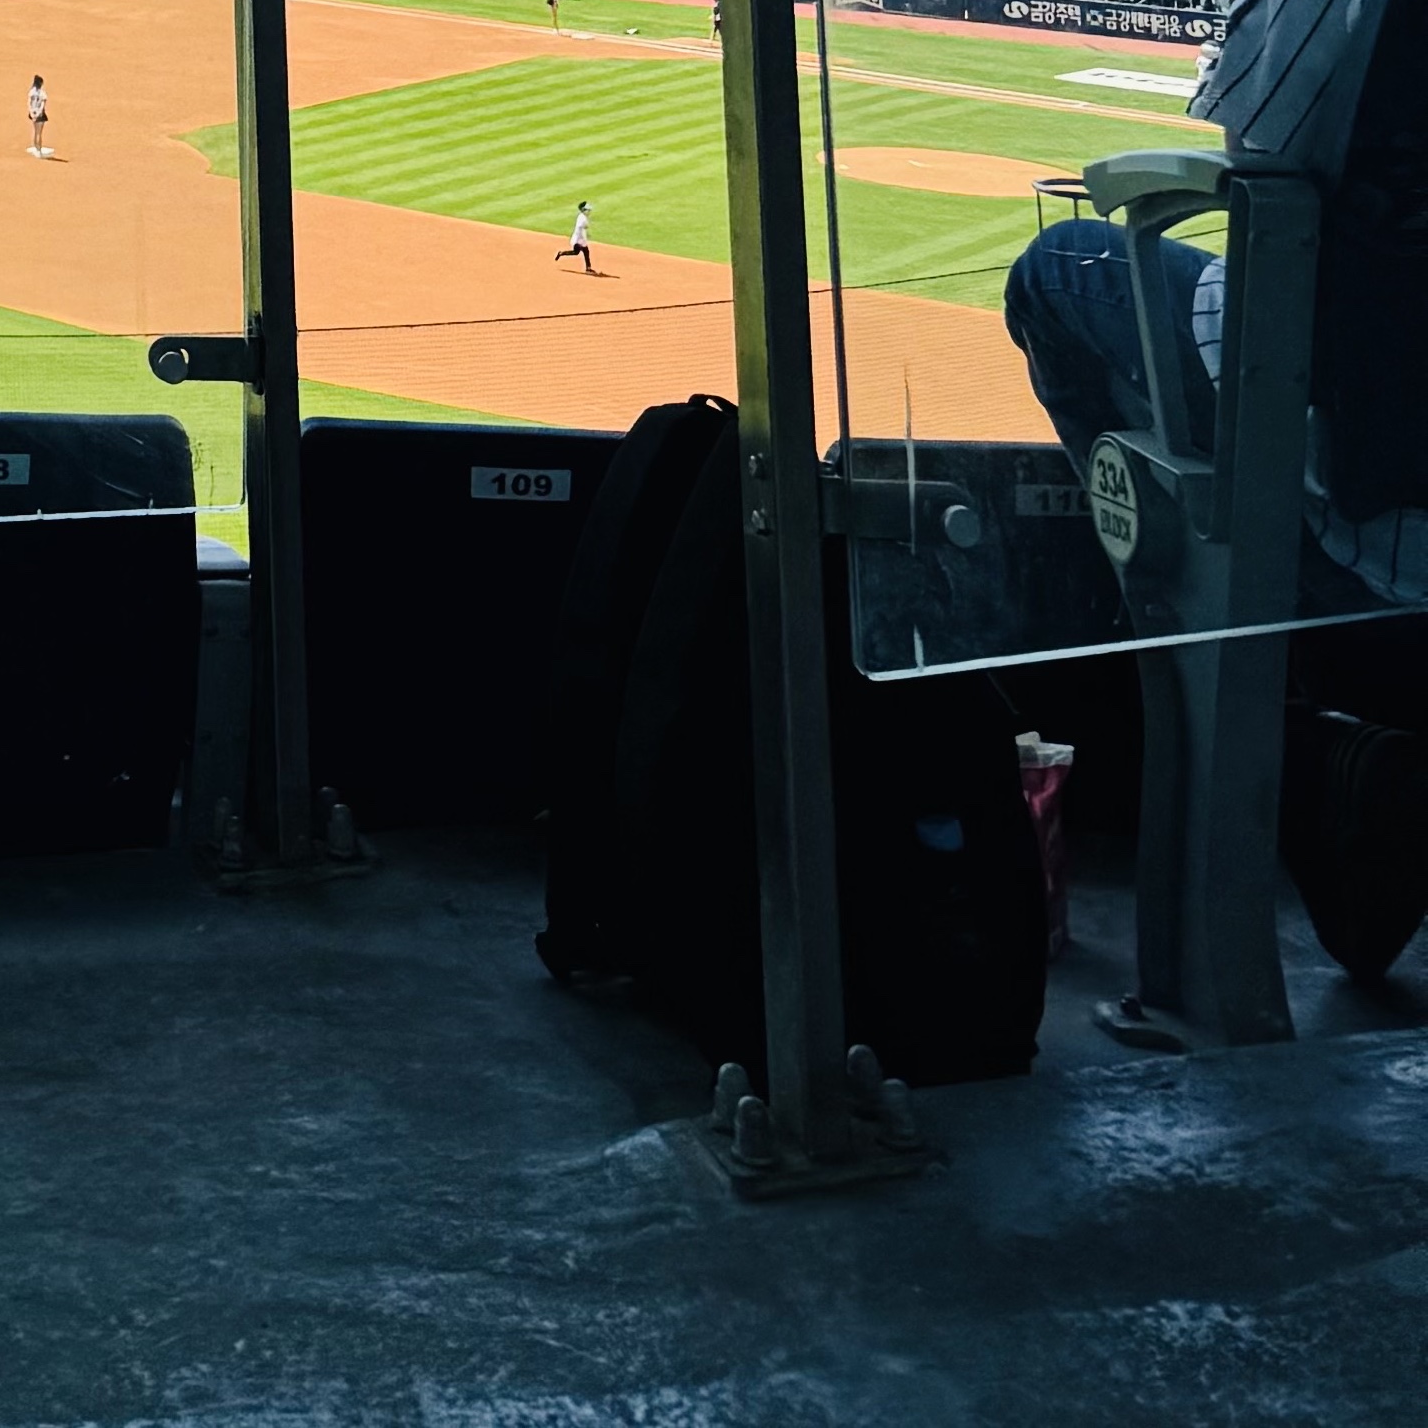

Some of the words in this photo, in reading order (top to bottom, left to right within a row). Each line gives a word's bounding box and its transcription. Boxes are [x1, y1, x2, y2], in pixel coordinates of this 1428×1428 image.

[1030, 1, 1082, 26] 금강주택
[1104, 8, 1183, 37] 금강펜테리움
[491, 473, 553, 497] 109
[1097, 459, 1129, 501] 334
[1099, 507, 1133, 543] BLOCK
